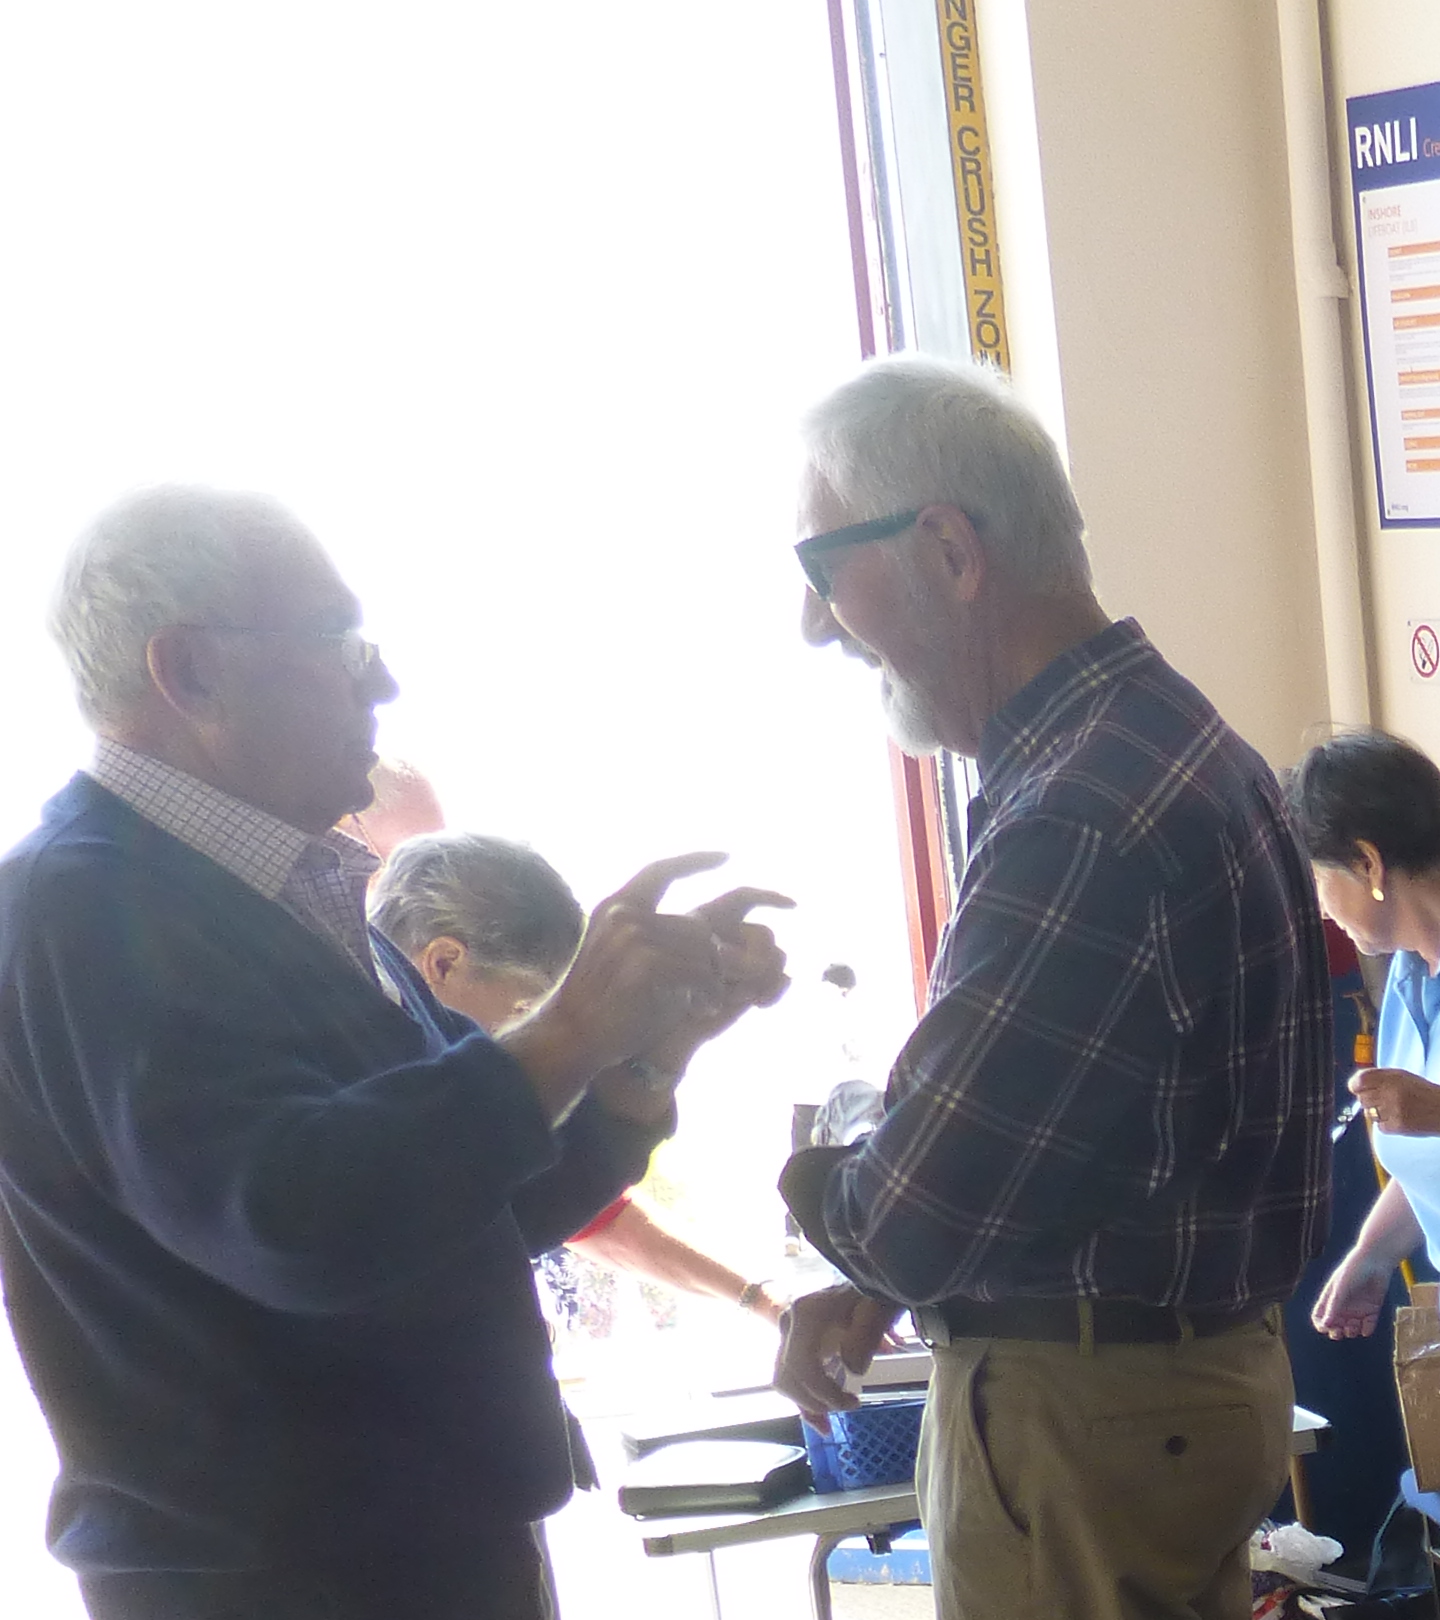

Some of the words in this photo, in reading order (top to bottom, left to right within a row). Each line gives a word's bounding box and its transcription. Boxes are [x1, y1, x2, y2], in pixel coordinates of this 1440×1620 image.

[1354, 116, 1418, 170] RNLI
[956, 125, 993, 278] CRUSH
[1368, 204, 1402, 221] INSHORE
